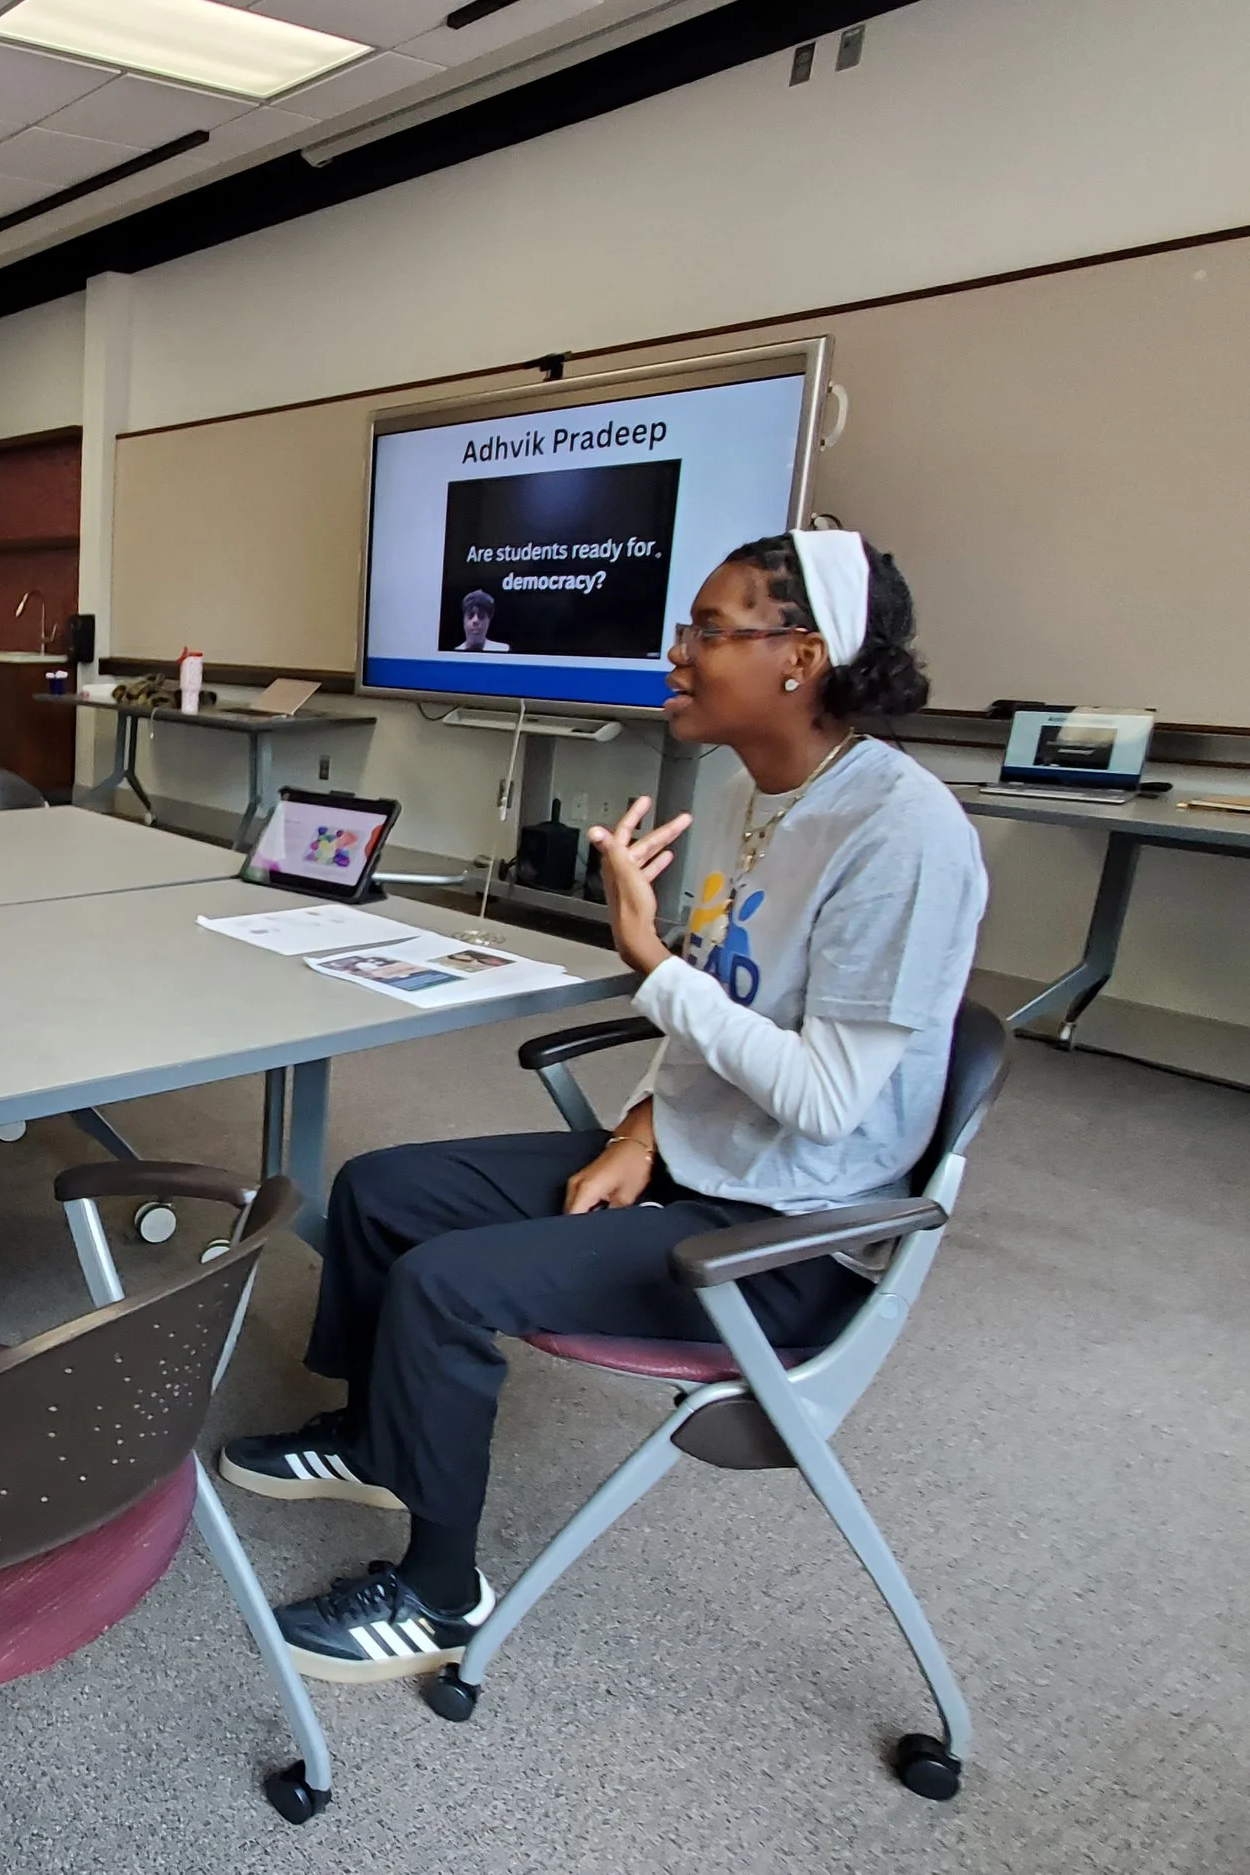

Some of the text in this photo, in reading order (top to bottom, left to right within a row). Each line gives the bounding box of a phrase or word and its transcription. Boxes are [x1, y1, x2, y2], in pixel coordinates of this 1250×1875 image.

[462, 420, 667, 464] Adhvik Pradeep
[466, 545, 493, 563] Are
[496, 542, 568, 562] students
[572, 538, 623, 563] ready
[502, 570, 607, 595] democracy?
